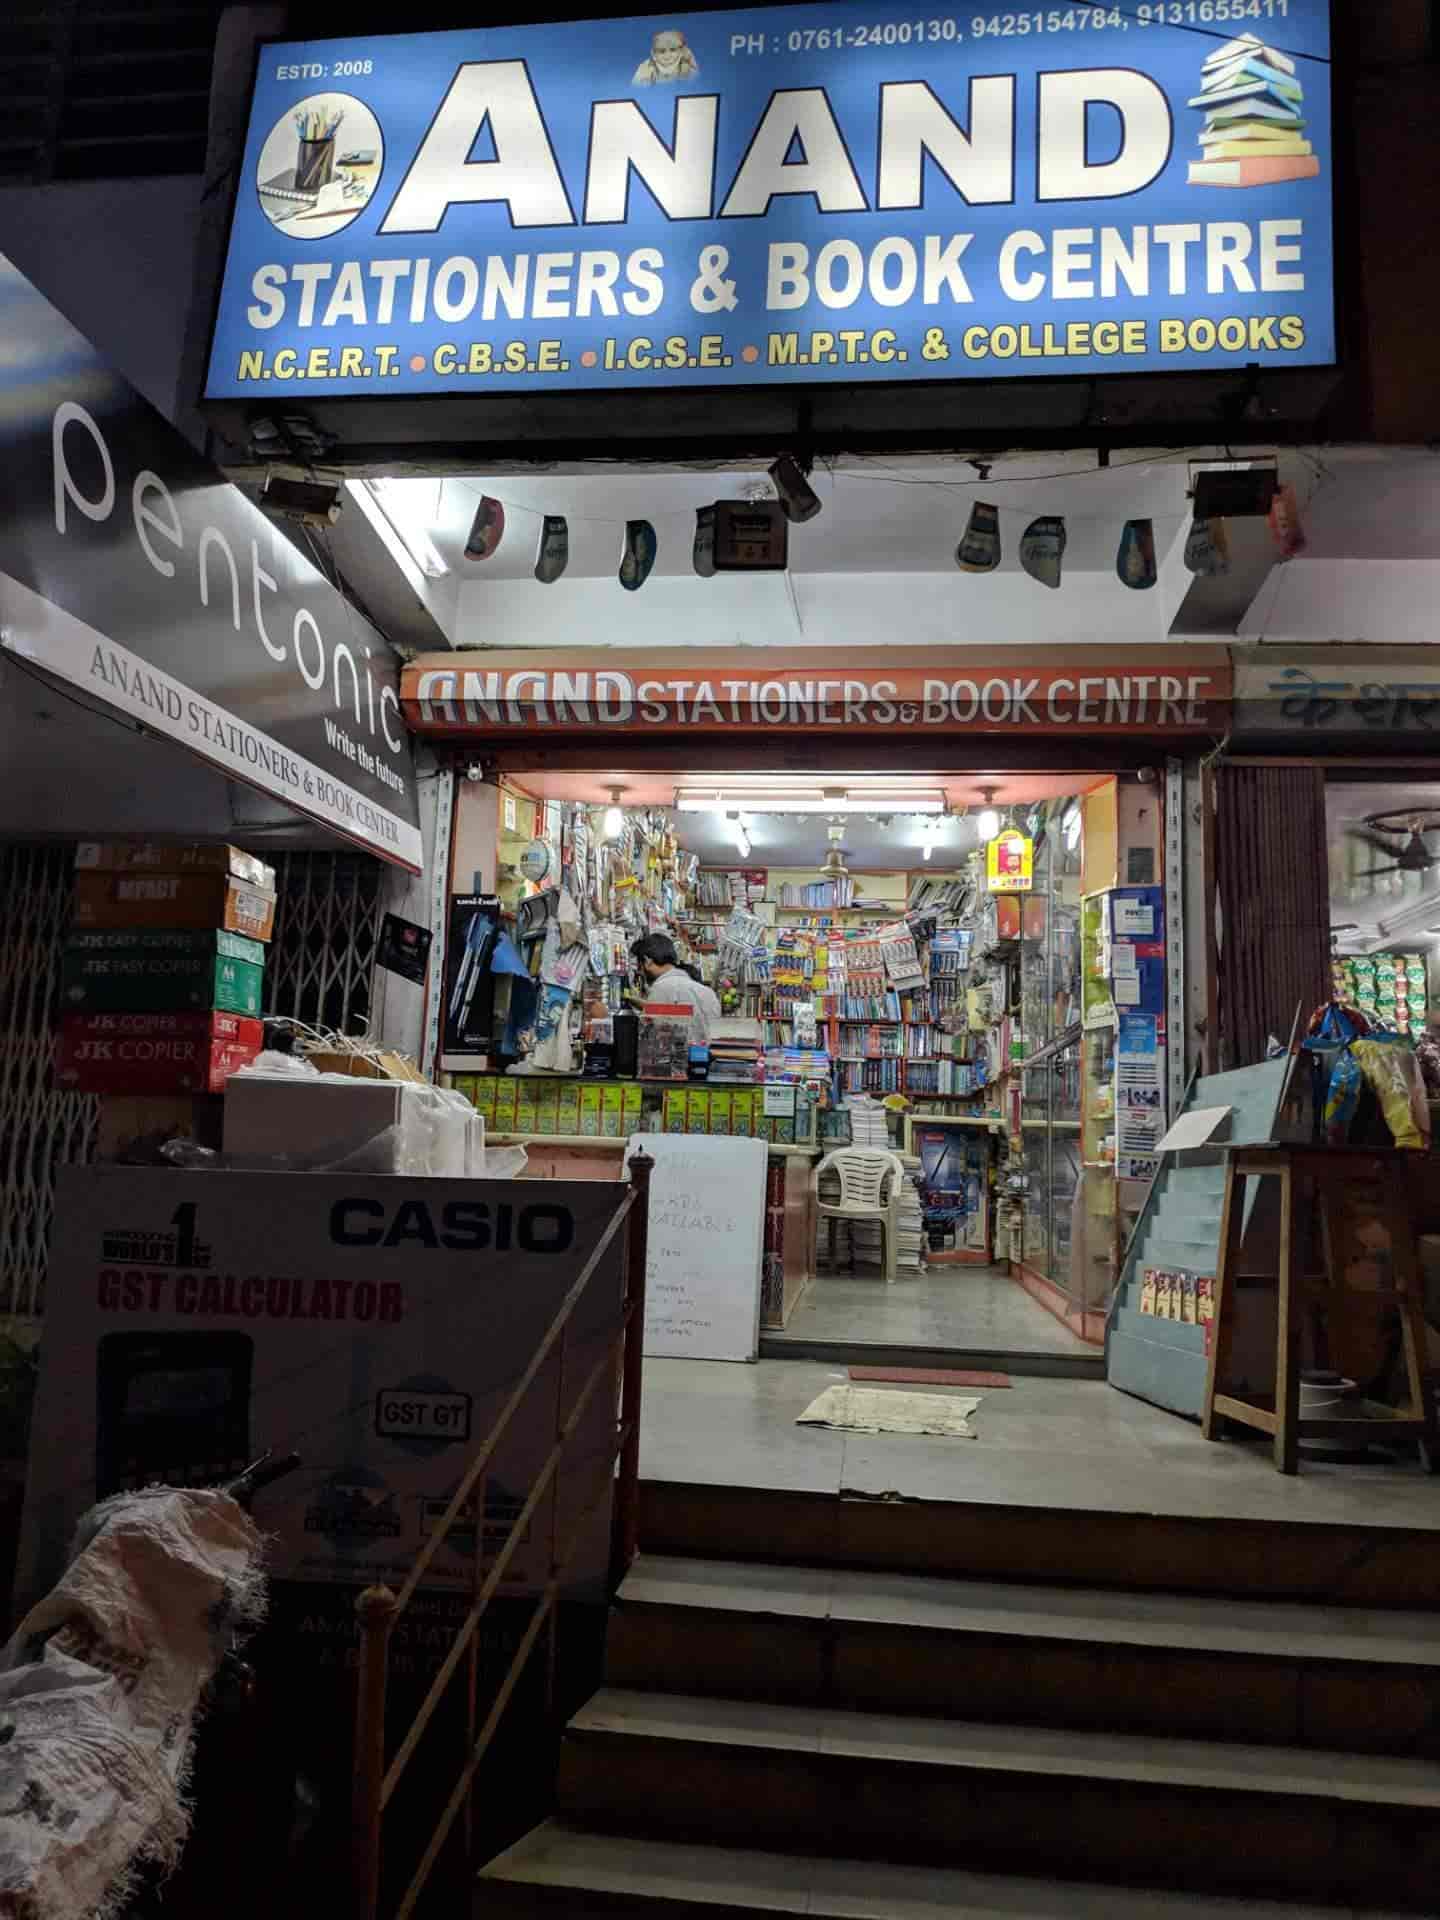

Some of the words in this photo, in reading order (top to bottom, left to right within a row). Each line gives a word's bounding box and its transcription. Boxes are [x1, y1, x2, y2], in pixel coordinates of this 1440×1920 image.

[729, 34, 765, 56] PH
[788, 19, 964, 52] 0761-2400130,
[971, 7, 1129, 40] 9425154784,
[1137, 0, 1289, 26] 9131655411
[276, 62, 328, 81] ESTD:
[334, 60, 373, 78] 2008
[376, 58, 1174, 235] ANAND
[247, 247, 664, 330] STATIONERS
[690, 244, 739, 313] &
[765, 232, 976, 311] BOOK
[999, 219, 1305, 301] CENTRE
[237, 345, 401, 381] N.C.E.R.T.
[432, 341, 571, 375] C.B.S.E.
[603, 335, 733, 370] I.C.S.E.
[767, 330, 909, 367] M.P.T.C.
[921, 328, 951, 363] &
[963, 321, 1147, 361] COLLEGE
[1160, 316, 1305, 355] BOOKS
[52, 401, 402, 754] pentonic
[416, 670, 636, 724] ANAND
[637, 680, 897, 725] STATIONERS
[922, 679, 1041, 724] BOOK
[1047, 675, 1211, 725] CENTRE
[89, 644, 183, 721] ANAND
[187, 701, 299, 787] STATIONERS
[317, 777, 354, 817] BOOK
[356, 800, 401, 842] CENTER
[324, 717, 357, 761] Write
[357, 743, 375, 774] the
[118, 1040, 197, 1062] COPIER
[329, 1197, 575, 1253] CASIO
[98, 1269, 168, 1312] GST
[174, 1273, 403, 1323] CALCULATOR
[384, 1401, 427, 1425] GST
[434, 1403, 465, 1427] GT
